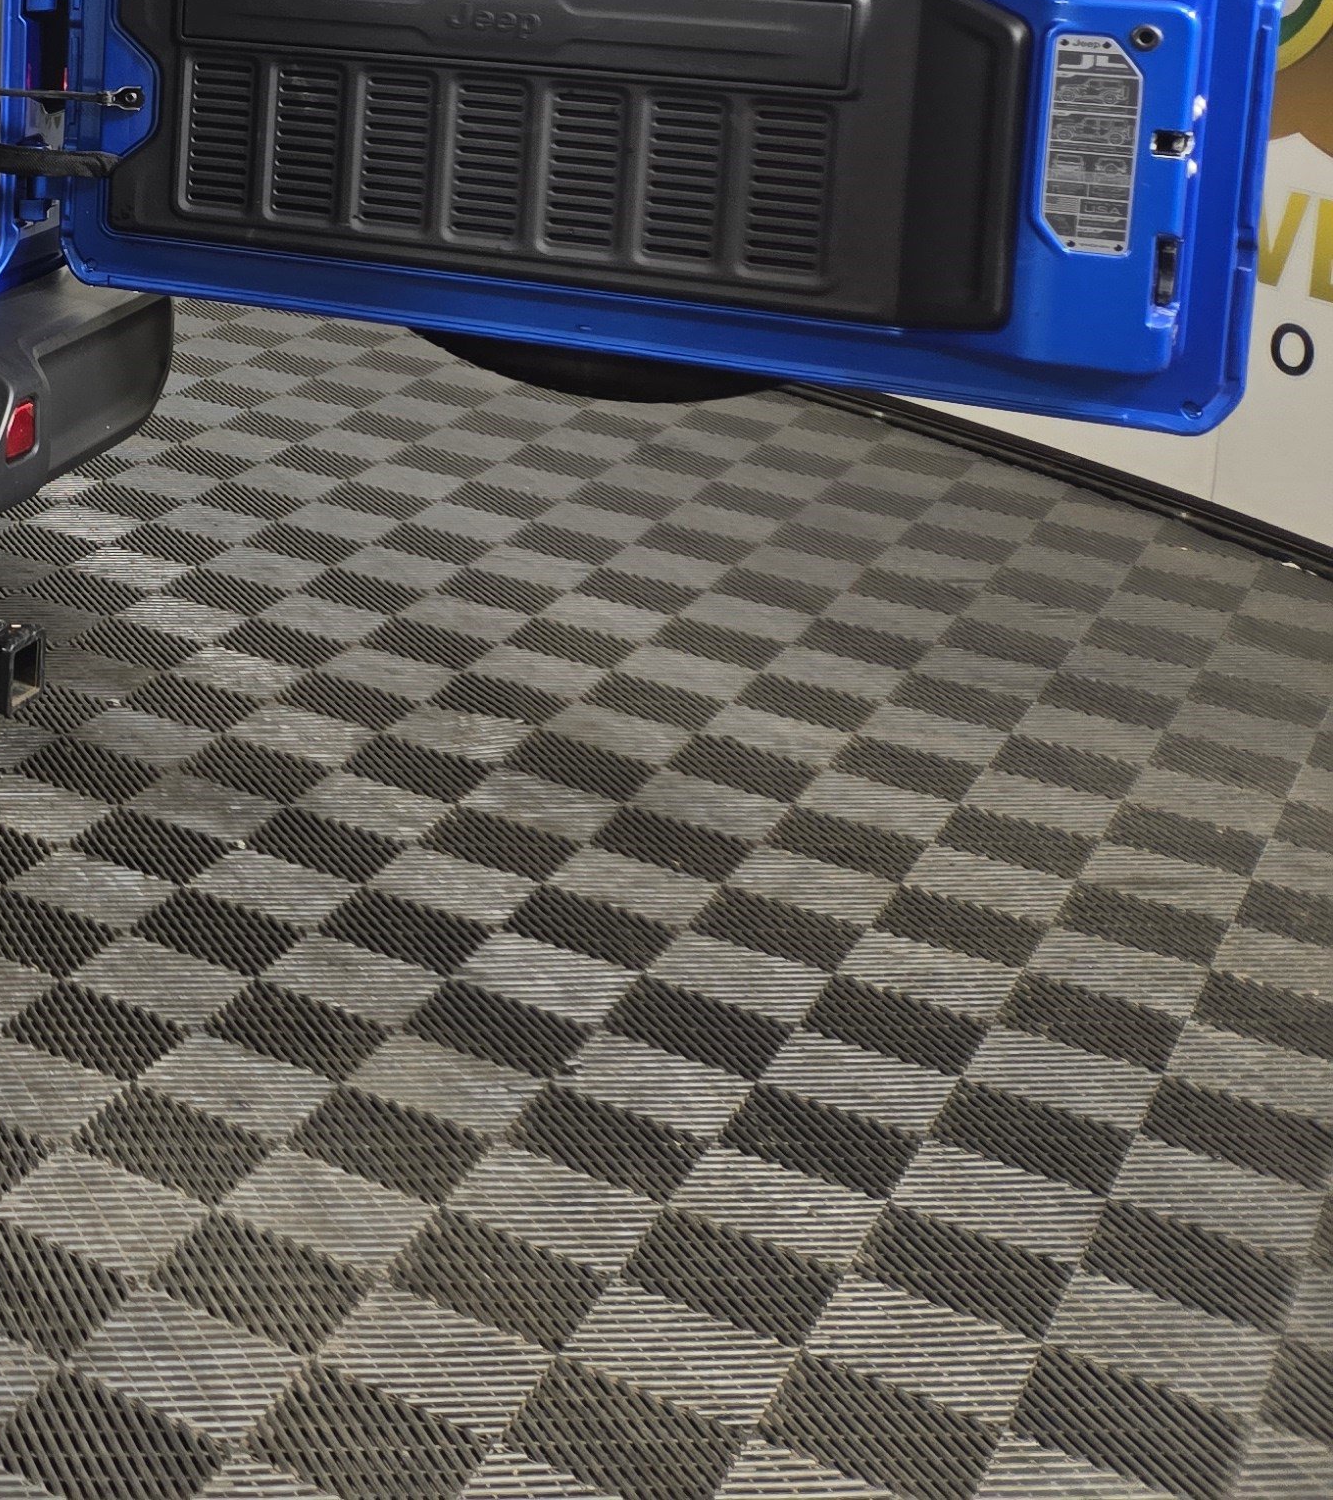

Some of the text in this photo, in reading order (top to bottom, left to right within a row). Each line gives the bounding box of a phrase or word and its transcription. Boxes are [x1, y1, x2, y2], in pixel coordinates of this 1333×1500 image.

[446, 1, 542, 40] Jeep
[1058, 54, 1129, 70] JL
[1083, 205, 1123, 216] USA
